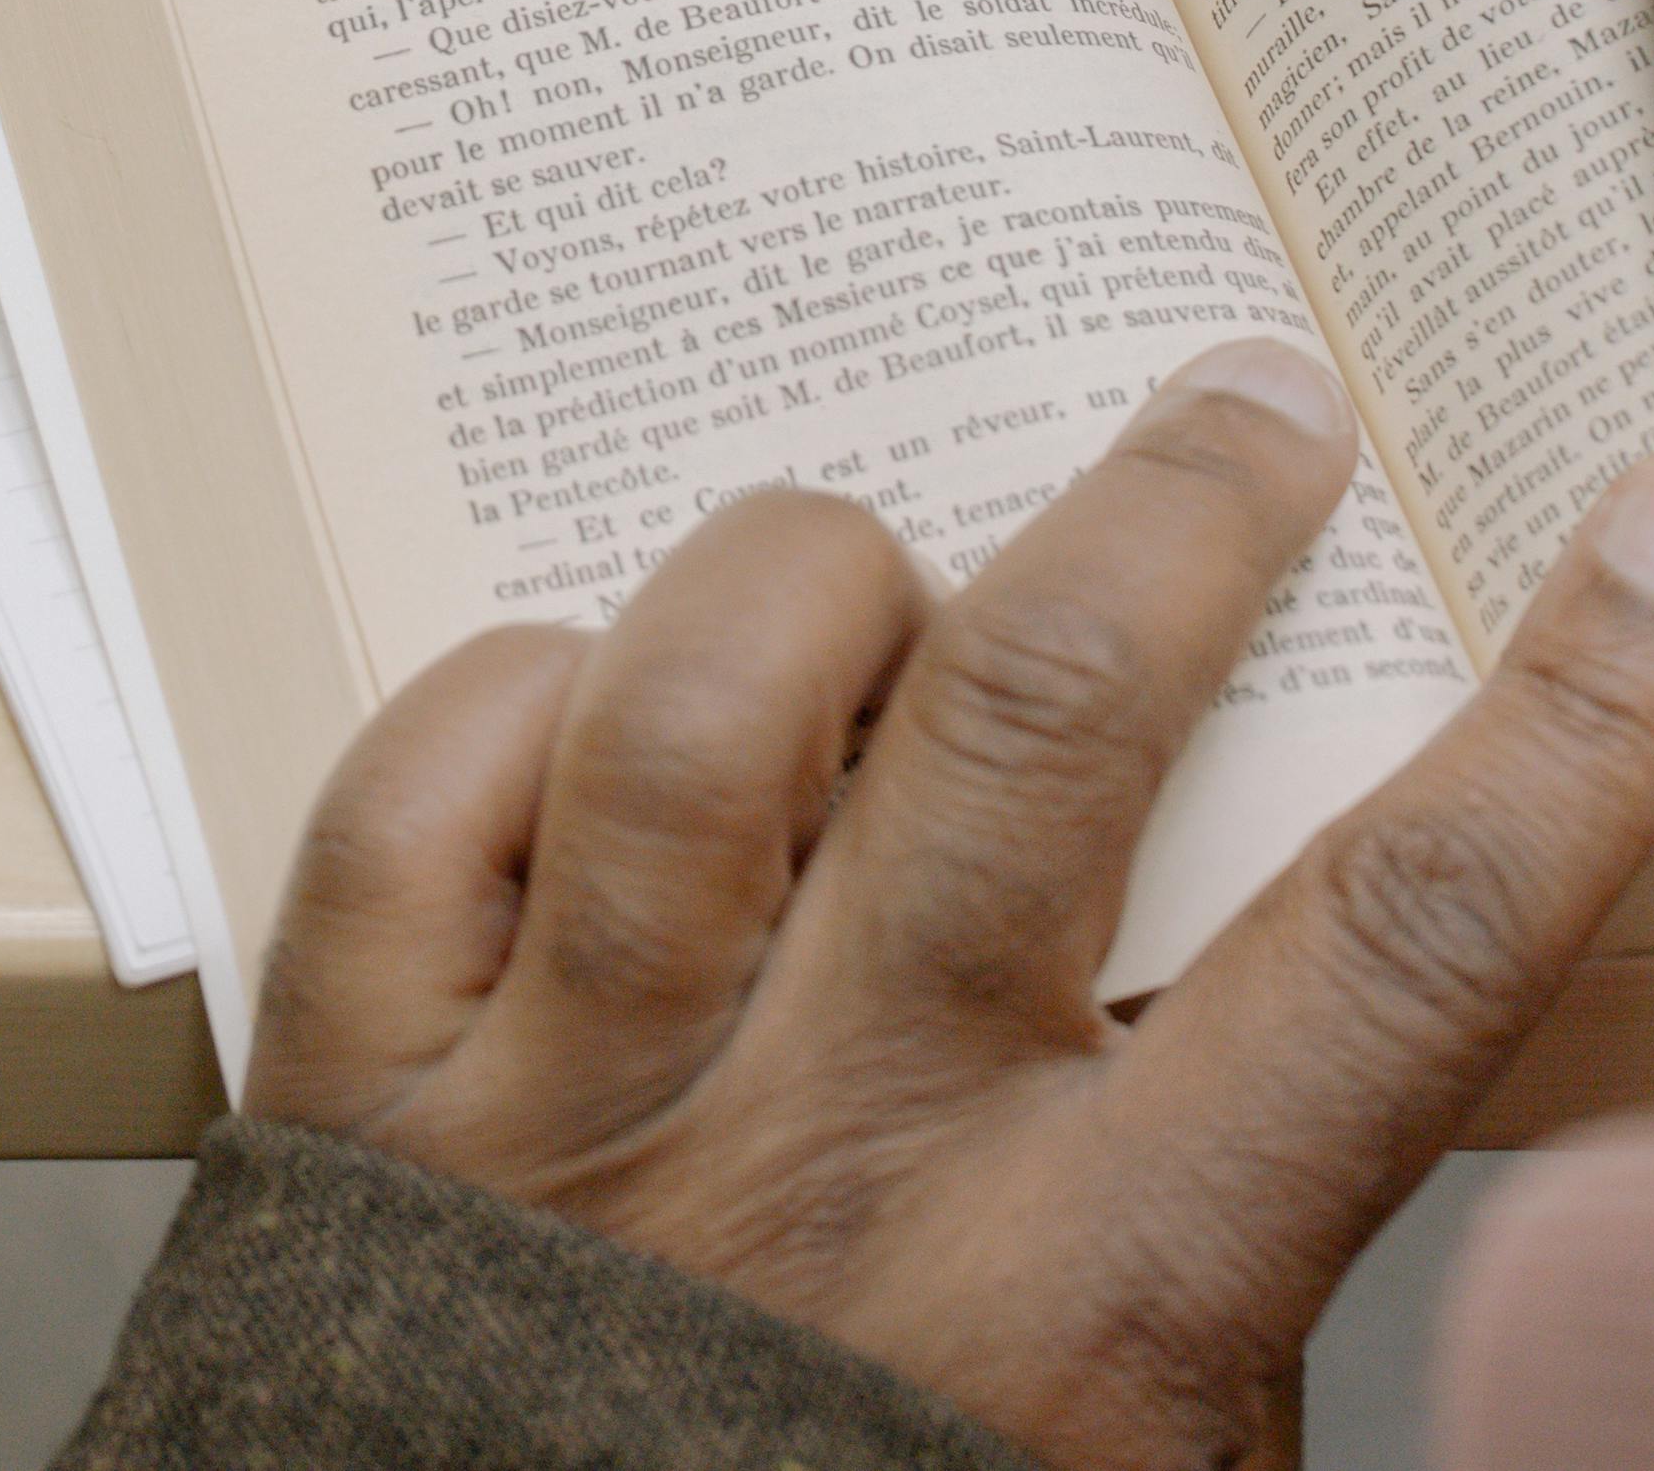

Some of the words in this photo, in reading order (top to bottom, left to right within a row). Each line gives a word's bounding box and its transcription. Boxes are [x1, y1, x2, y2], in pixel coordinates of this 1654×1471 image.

[327, 5, 389, 44] qui,
[348, 57, 506, 112] caressant,
[514, 43, 571, 77] que
[578, 26, 622, 56] M.
[634, 15, 670, 42] de
[380, 179, 483, 223] devait
[490, 174, 521, 197] se
[531, 146, 646, 187] sauver.
[411, 310, 441, 338] le
[451, 288, 539, 335] garde
[549, 282, 580, 305] se
[589, 239, 731, 295] tournant
[739, 223, 808, 254] vers
[812, 210, 842, 236] le
[852, 179, 1011, 226] narrateur.
[468, 500, 501, 526] la
[509, 465, 679, 517] Pentecôte.
